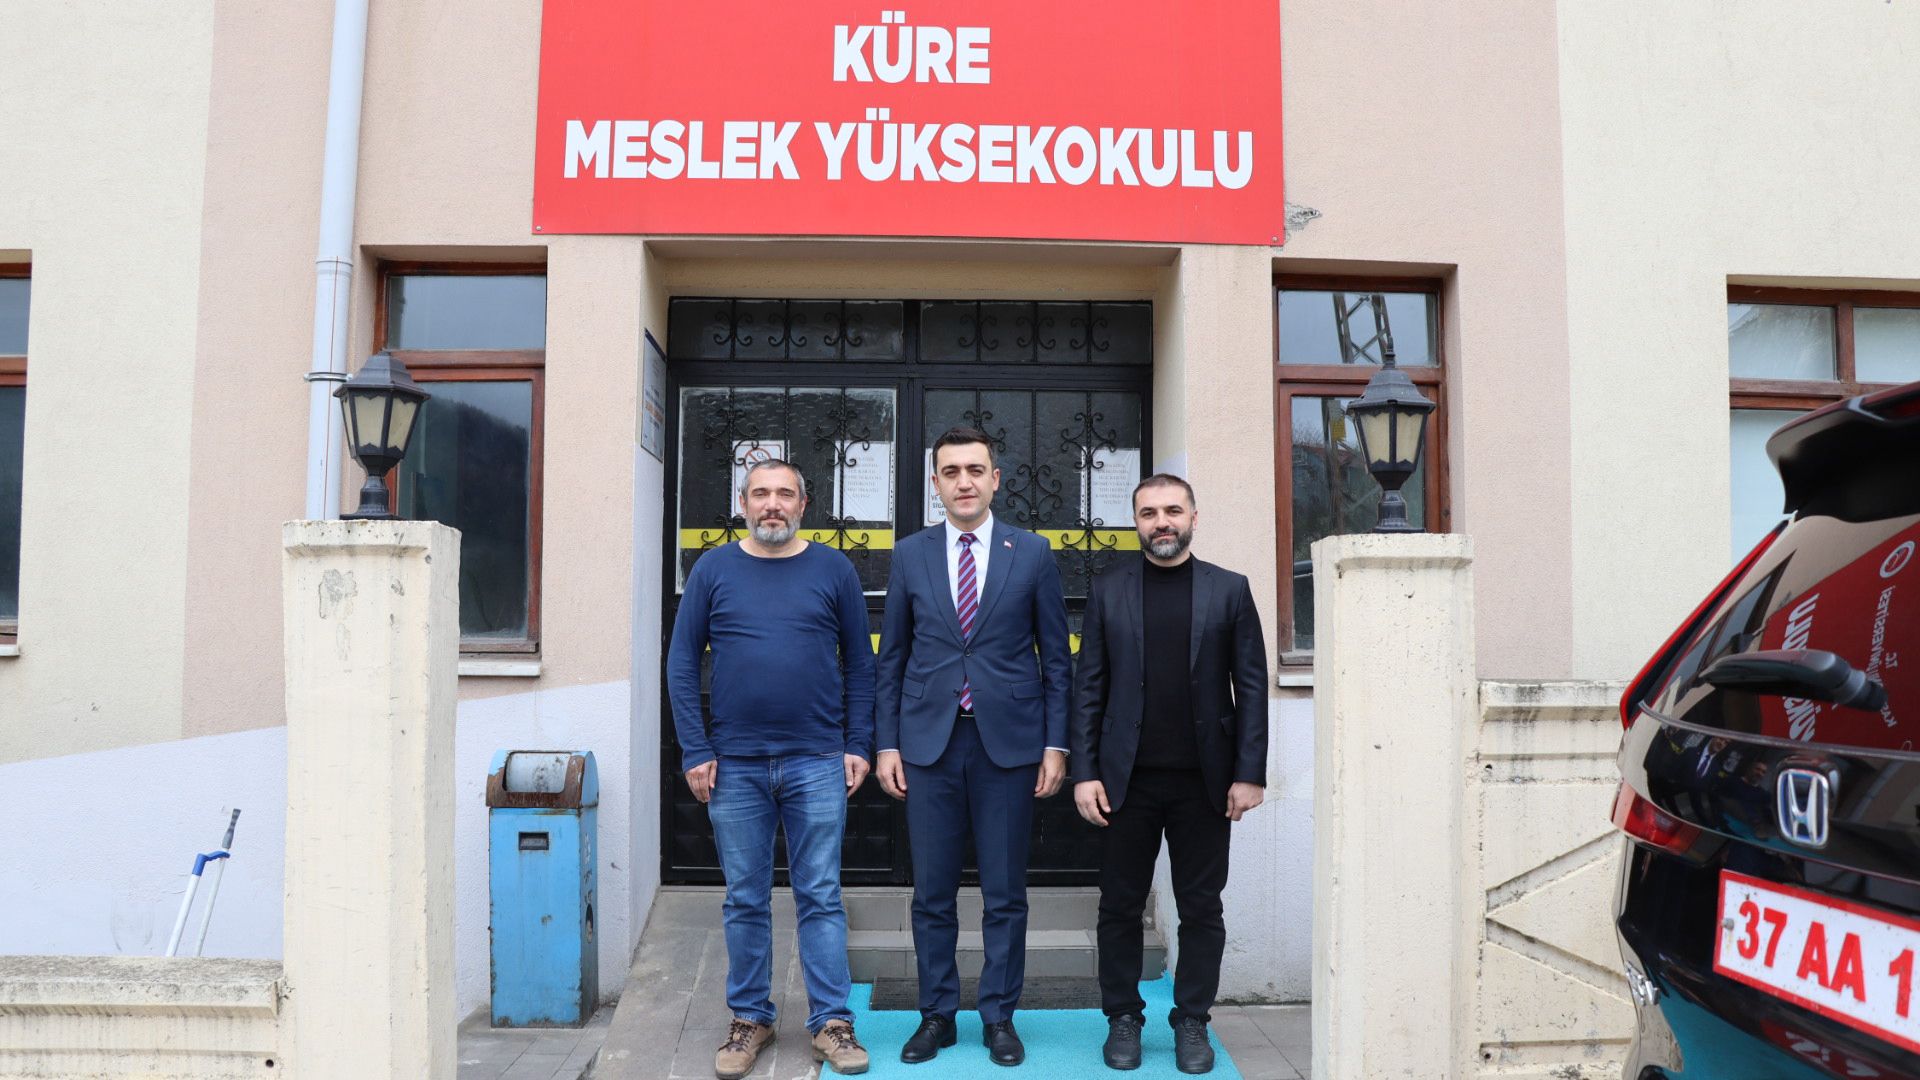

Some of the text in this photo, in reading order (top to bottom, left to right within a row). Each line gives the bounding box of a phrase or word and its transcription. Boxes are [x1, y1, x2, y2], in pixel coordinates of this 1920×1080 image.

[833, 11, 990, 84] KÜRE
[564, 107, 1253, 189] MESLEK YÜKSEKOKULU
[1737, 900, 1787, 968] 37
[1796, 921, 1866, 1003] AA
